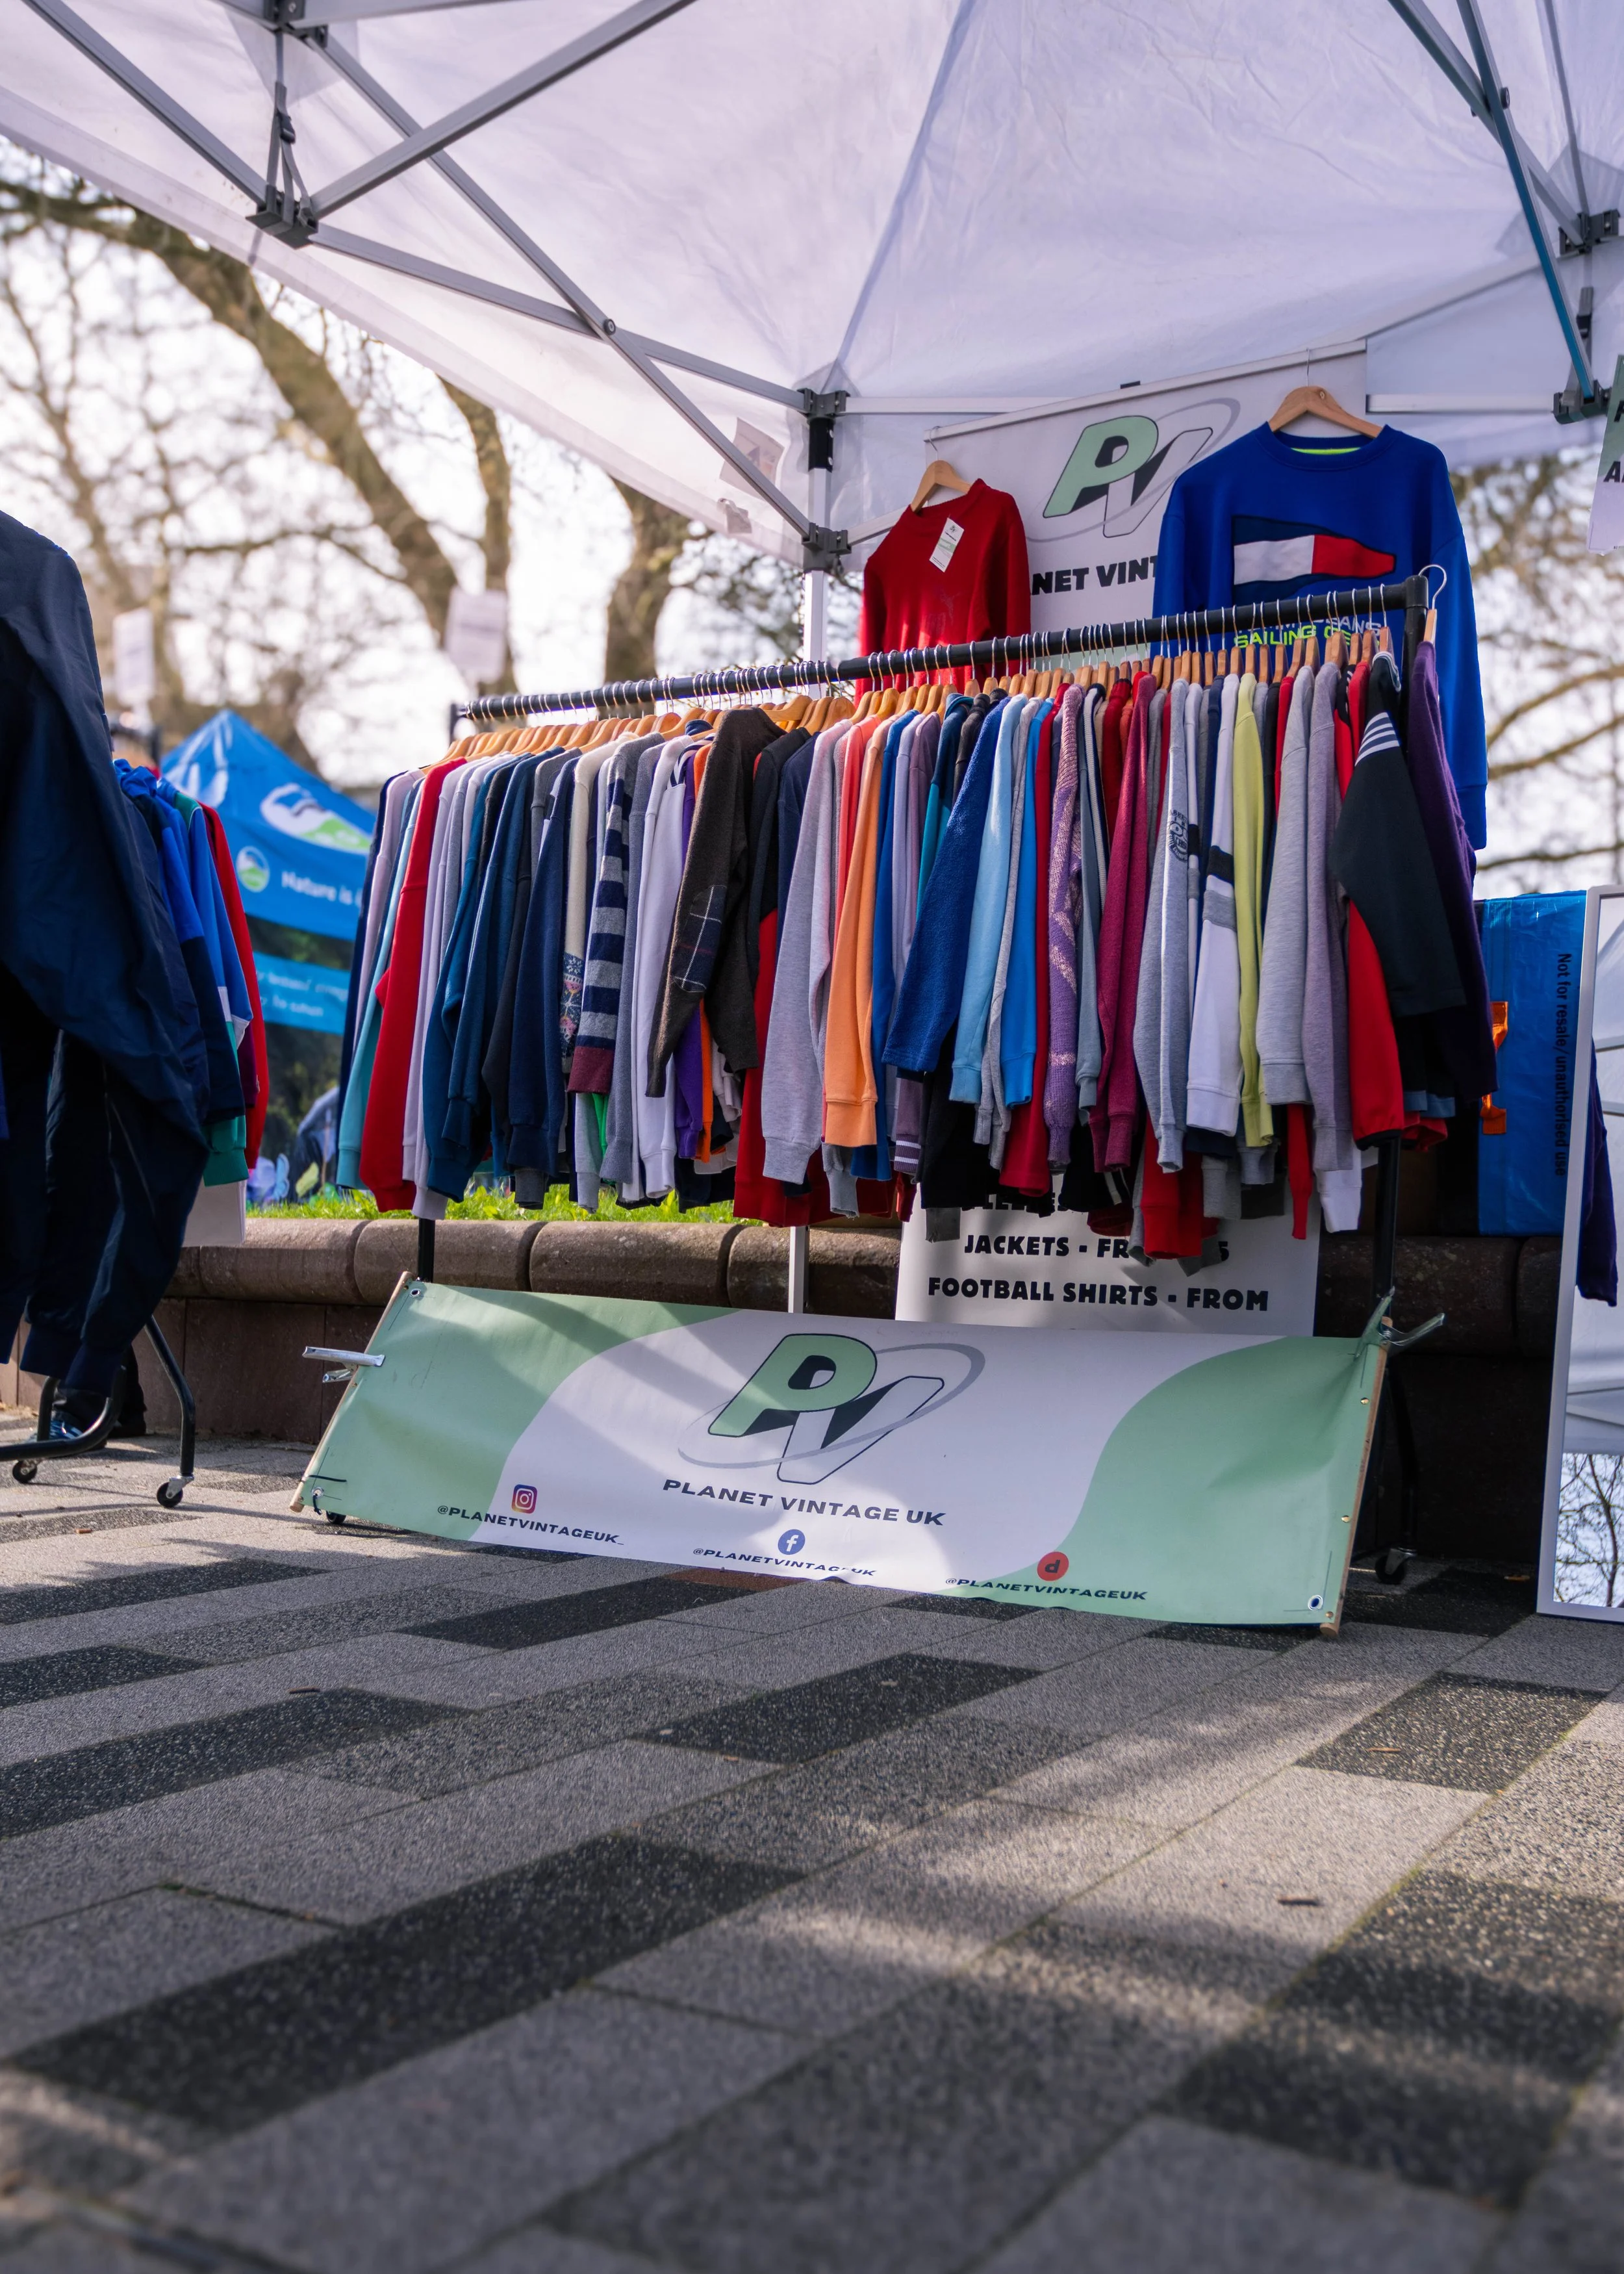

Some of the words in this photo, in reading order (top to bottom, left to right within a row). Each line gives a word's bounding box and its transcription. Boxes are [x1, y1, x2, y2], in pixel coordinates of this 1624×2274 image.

[1031, 567, 1089, 596] NET
[1234, 624, 1317, 648] SAILING
[1558, 953, 1572, 978] Not
[1556, 981, 1571, 1000] for
[1554, 1151, 1567, 1177] use
[964, 1234, 1069, 1257] JACKETS
[1097, 1238, 1130, 1258] FR
[928, 1277, 1054, 1301] FOOTBALL
[1063, 1282, 1158, 1307] SHIRTS
[1187, 1287, 1269, 1312] FROM
[663, 1479, 773, 1507] PLANET
[780, 1496, 900, 1522] VINTAGE
[906, 1510, 946, 1526] UK
[692, 1548, 878, 1577] @PLANETVINTAGUK
[945, 1578, 1148, 1601] @PLANETVINTAGEUK
